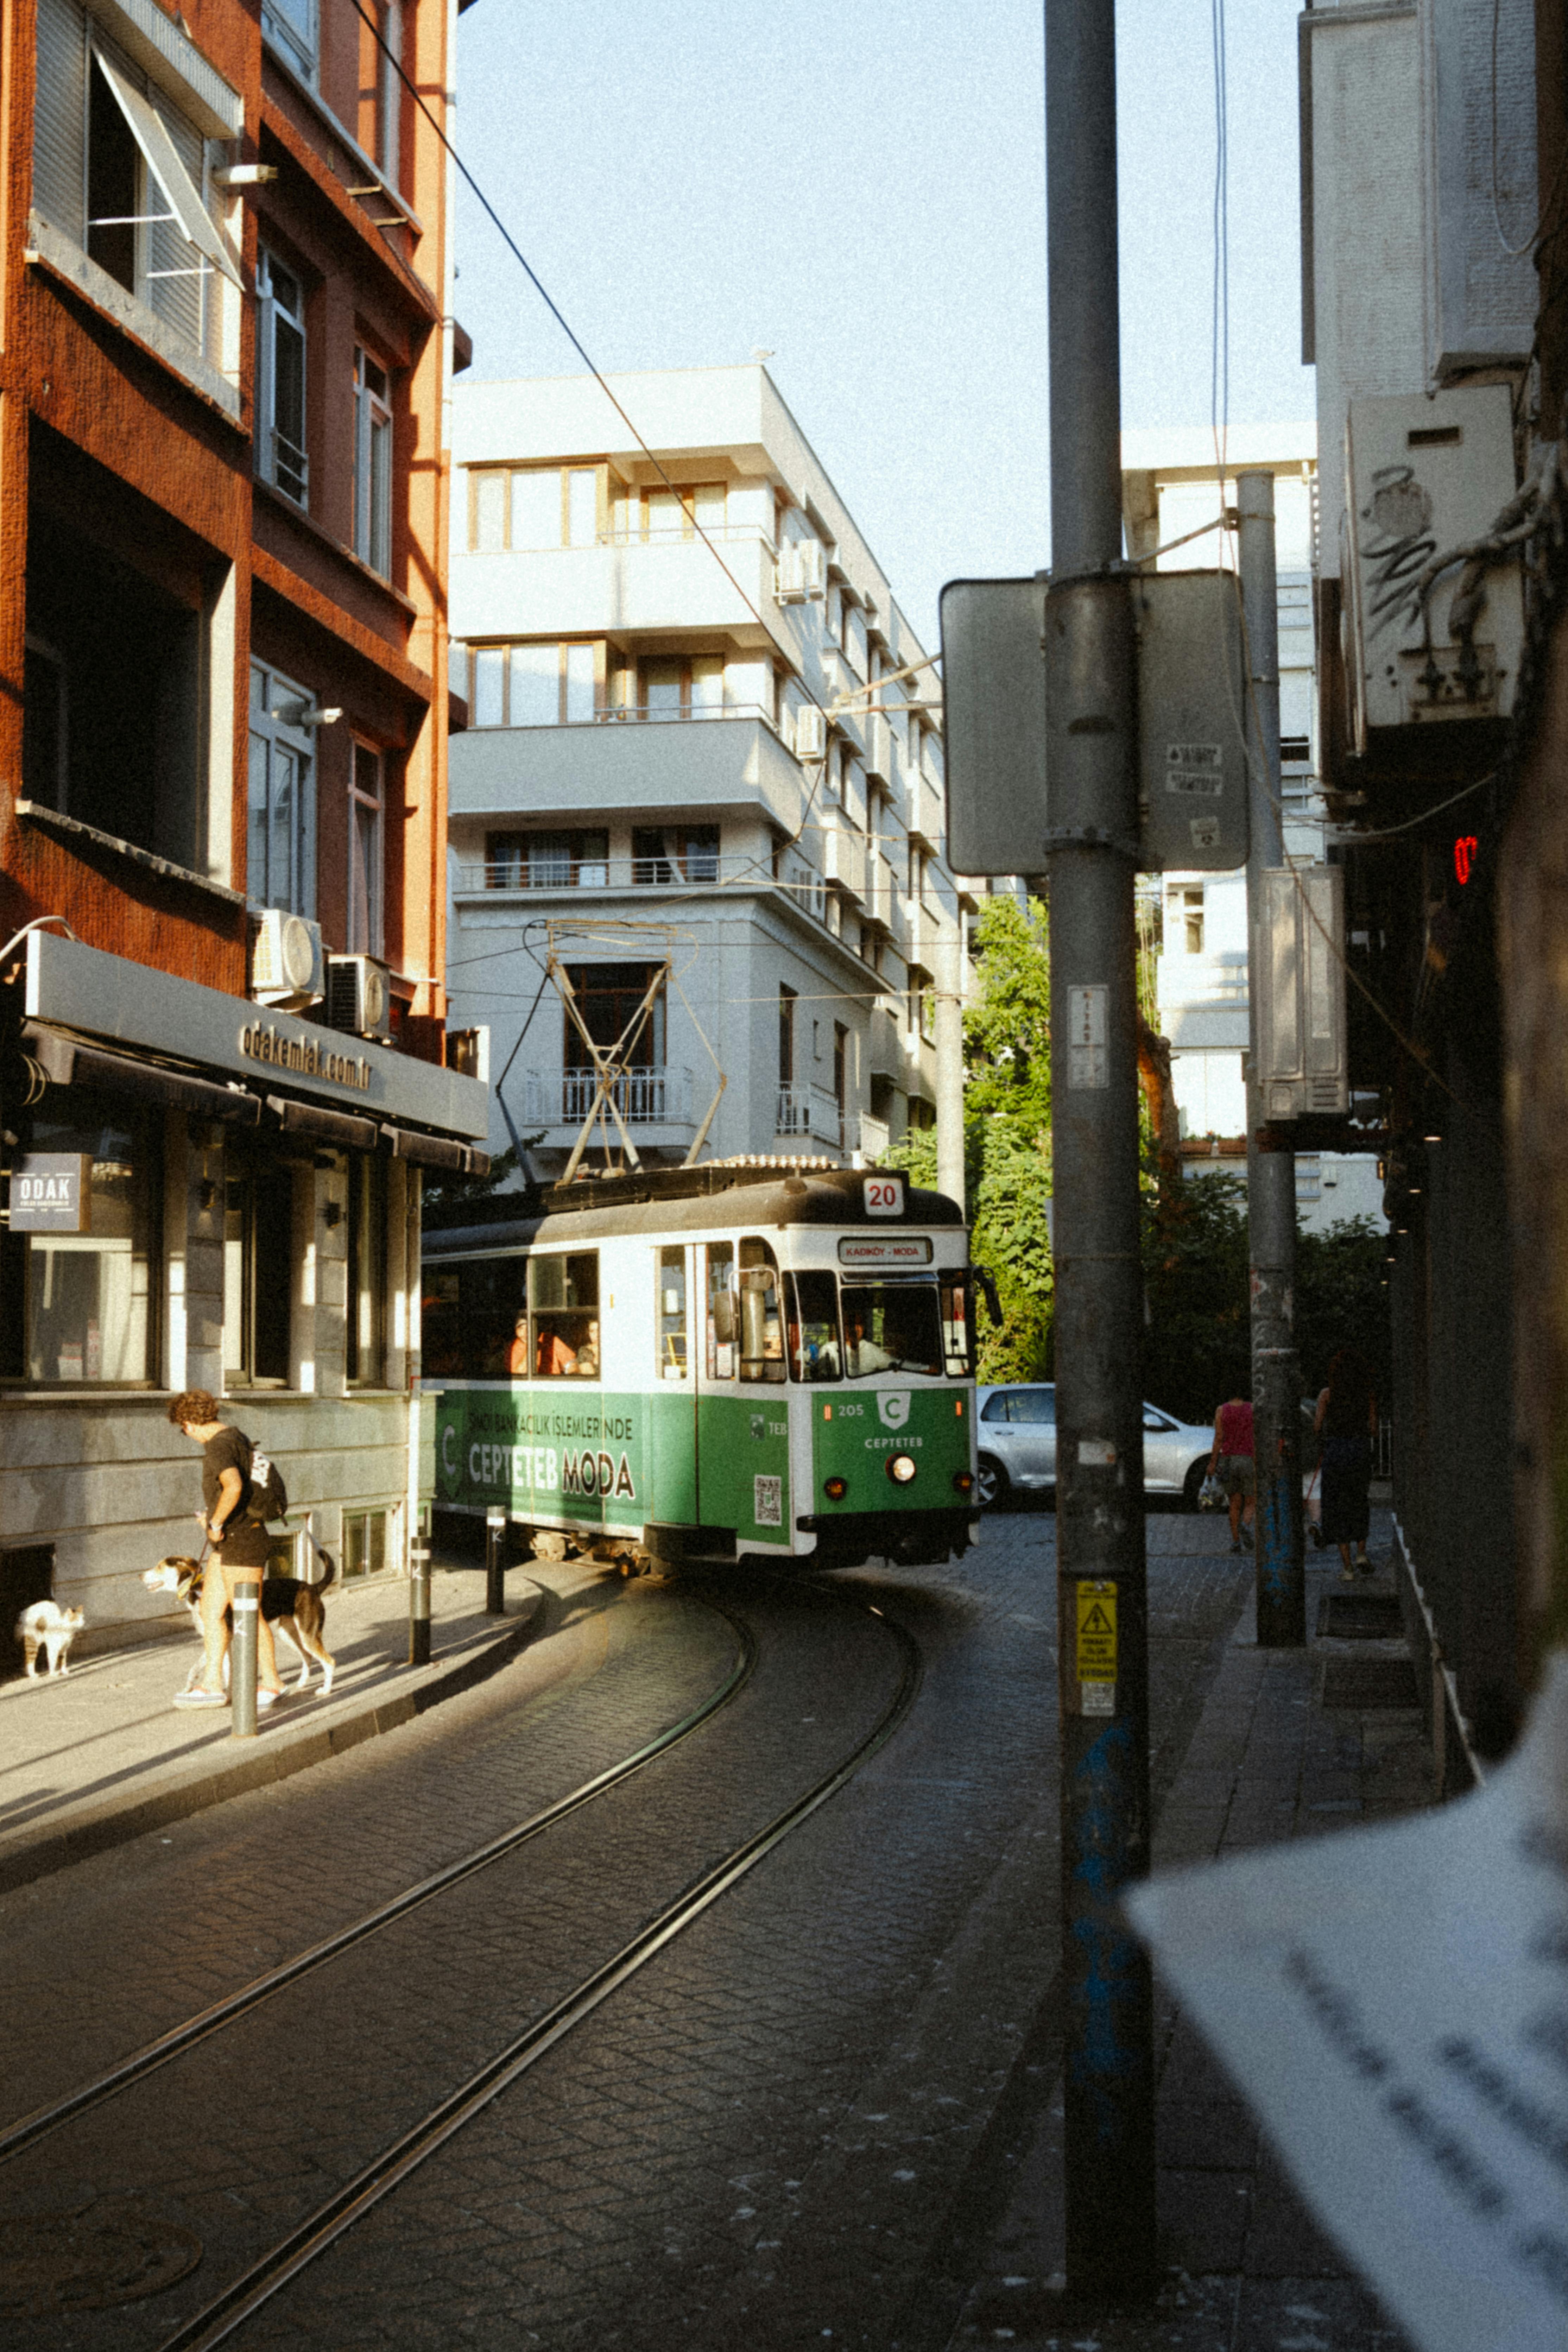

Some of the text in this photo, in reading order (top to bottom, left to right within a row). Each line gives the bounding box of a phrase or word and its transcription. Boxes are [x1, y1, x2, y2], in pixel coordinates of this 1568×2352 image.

[239, 1020, 372, 1090] odakemlak.com.tr
[20, 1178, 70, 1200] ODAK
[868, 1185, 896, 1206] 20
[846, 1247, 885, 1256] KADIKÖY
[893, 1247, 918, 1256] MODA
[838, 1404, 864, 1417] 205
[769, 1422, 787, 1435] TEB
[864, 1437, 923, 1449] CEPTETEB
[469, 1443, 636, 1500] CEPTETEB MODA
